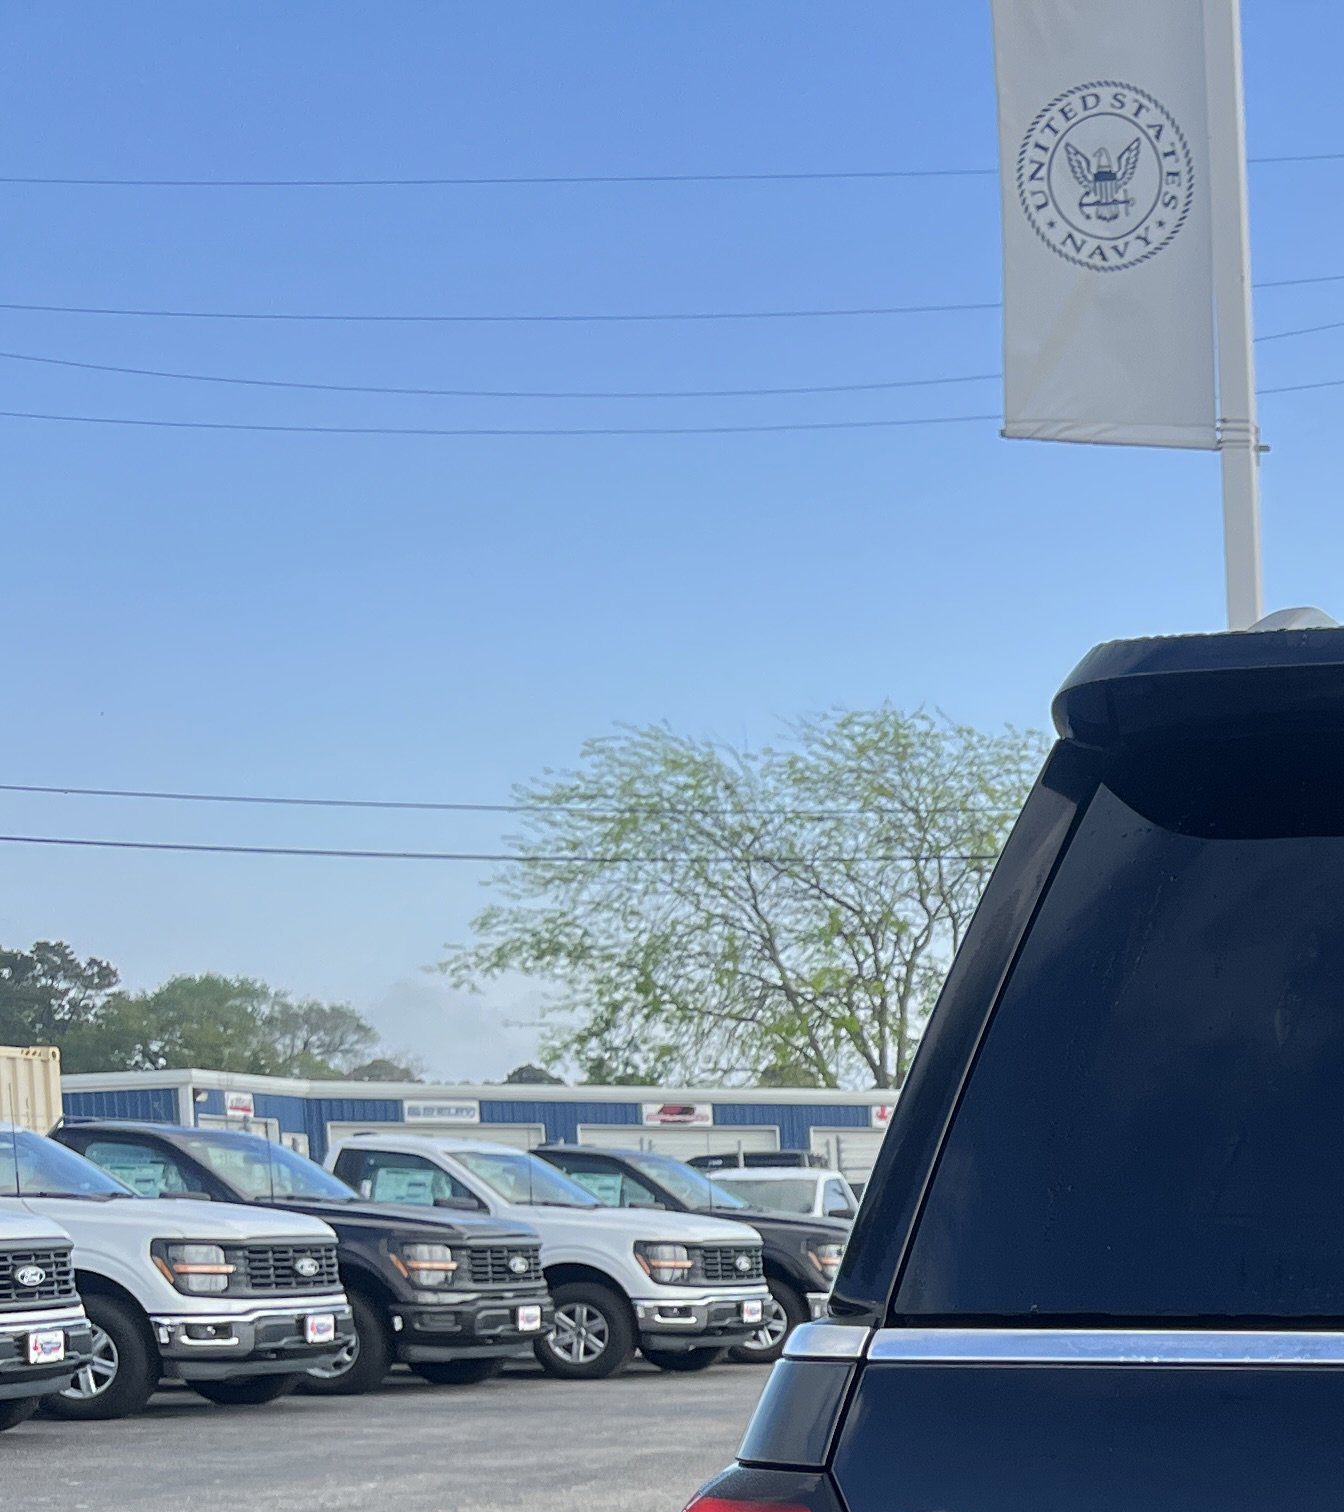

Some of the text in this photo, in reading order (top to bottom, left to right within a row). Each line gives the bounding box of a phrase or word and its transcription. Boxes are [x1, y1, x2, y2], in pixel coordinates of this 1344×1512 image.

[1028, 93, 1182, 212] UNITED STATES
[1061, 226, 1152, 262] NAVY
